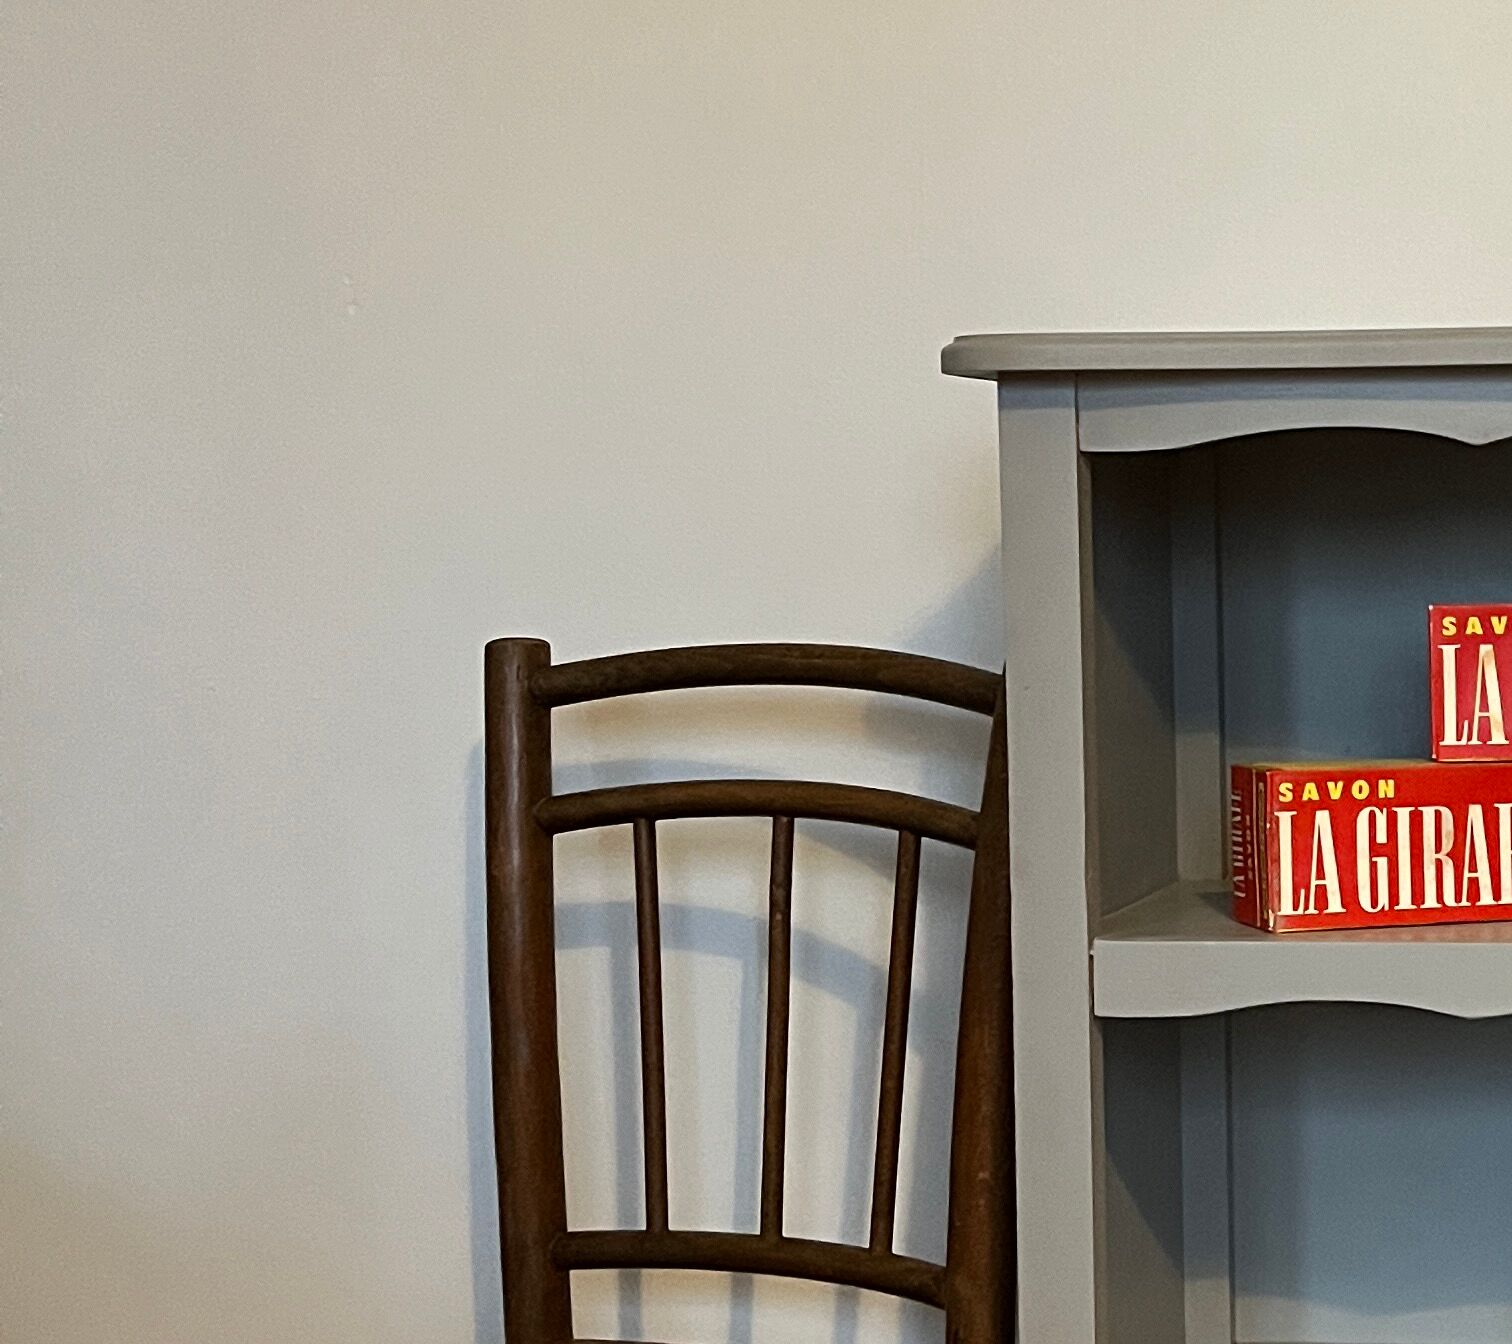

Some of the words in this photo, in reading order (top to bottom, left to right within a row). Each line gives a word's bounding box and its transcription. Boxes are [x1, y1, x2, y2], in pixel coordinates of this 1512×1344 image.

[1438, 642, 1510, 747] LA
[1278, 778, 1395, 803] SAVON
[1274, 808, 1347, 917] LA
